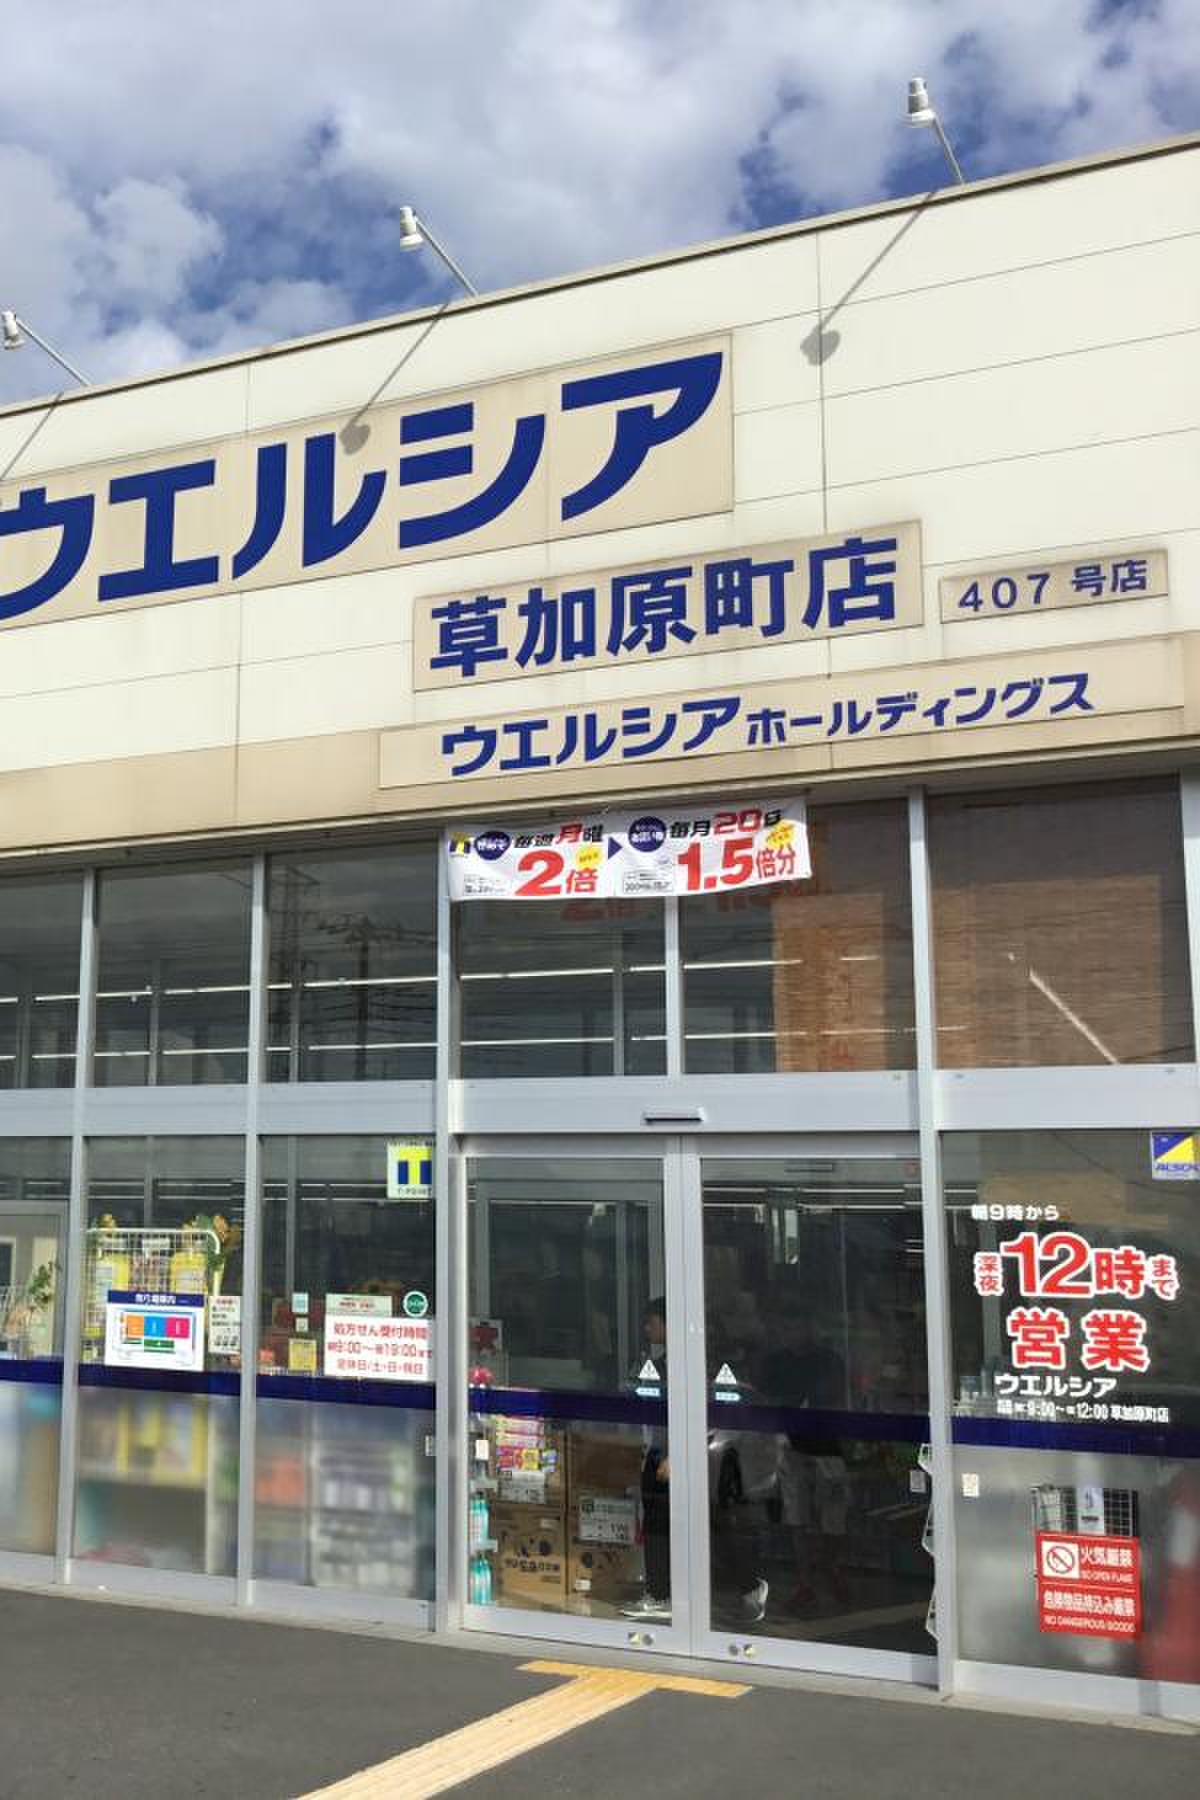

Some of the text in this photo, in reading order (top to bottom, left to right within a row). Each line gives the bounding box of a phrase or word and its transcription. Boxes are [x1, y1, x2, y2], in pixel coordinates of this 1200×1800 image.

[429, 536, 898, 677] 草加原町店
[958, 559, 1148, 612] 407 号店
[441, 672, 1093, 777] ウエルシア ホールディングス
[514, 849, 599, 896] 2倍
[1007, 1307, 1150, 1372] 営業
[994, 1374, 1118, 1398] ウエルシア
